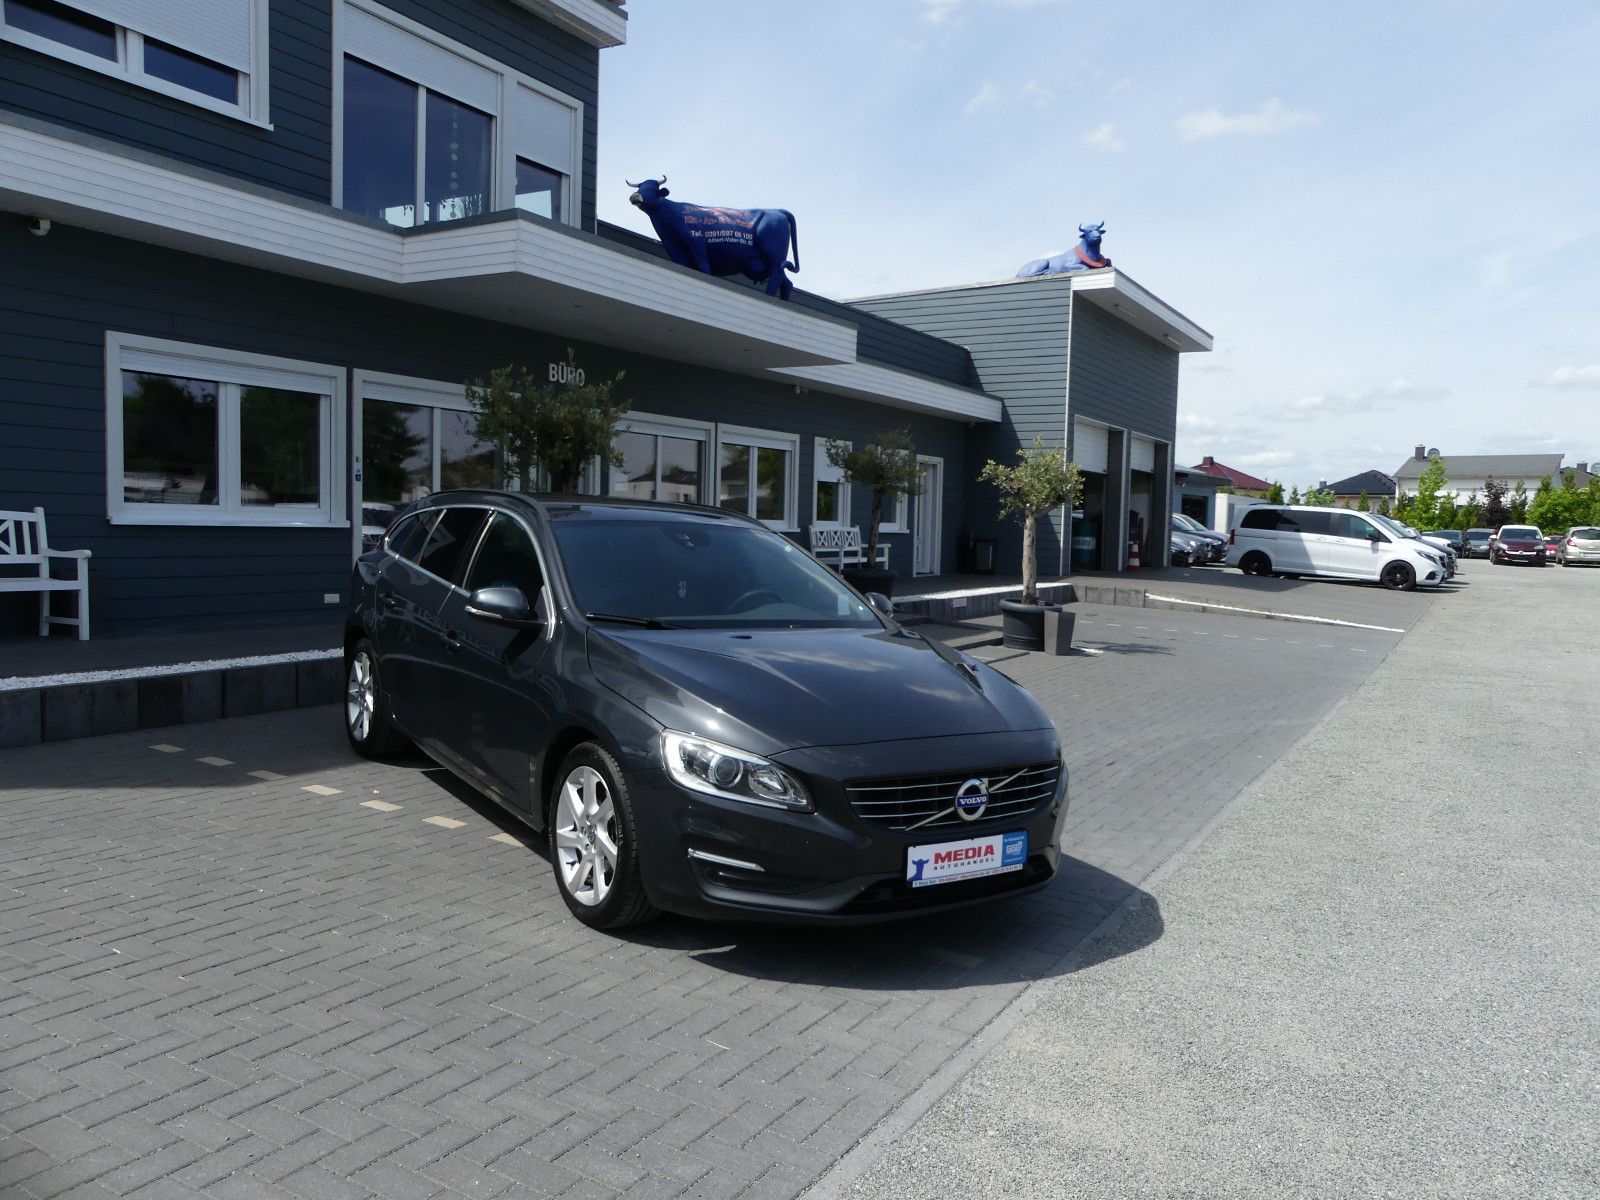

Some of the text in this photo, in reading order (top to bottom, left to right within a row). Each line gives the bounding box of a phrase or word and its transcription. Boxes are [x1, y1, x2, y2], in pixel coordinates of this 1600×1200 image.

[549, 361, 585, 387] BÜRO
[960, 796, 987, 805] VOLVO
[934, 845, 995, 864] MEDIA
[933, 858, 995, 871] AUTOHANDEL
